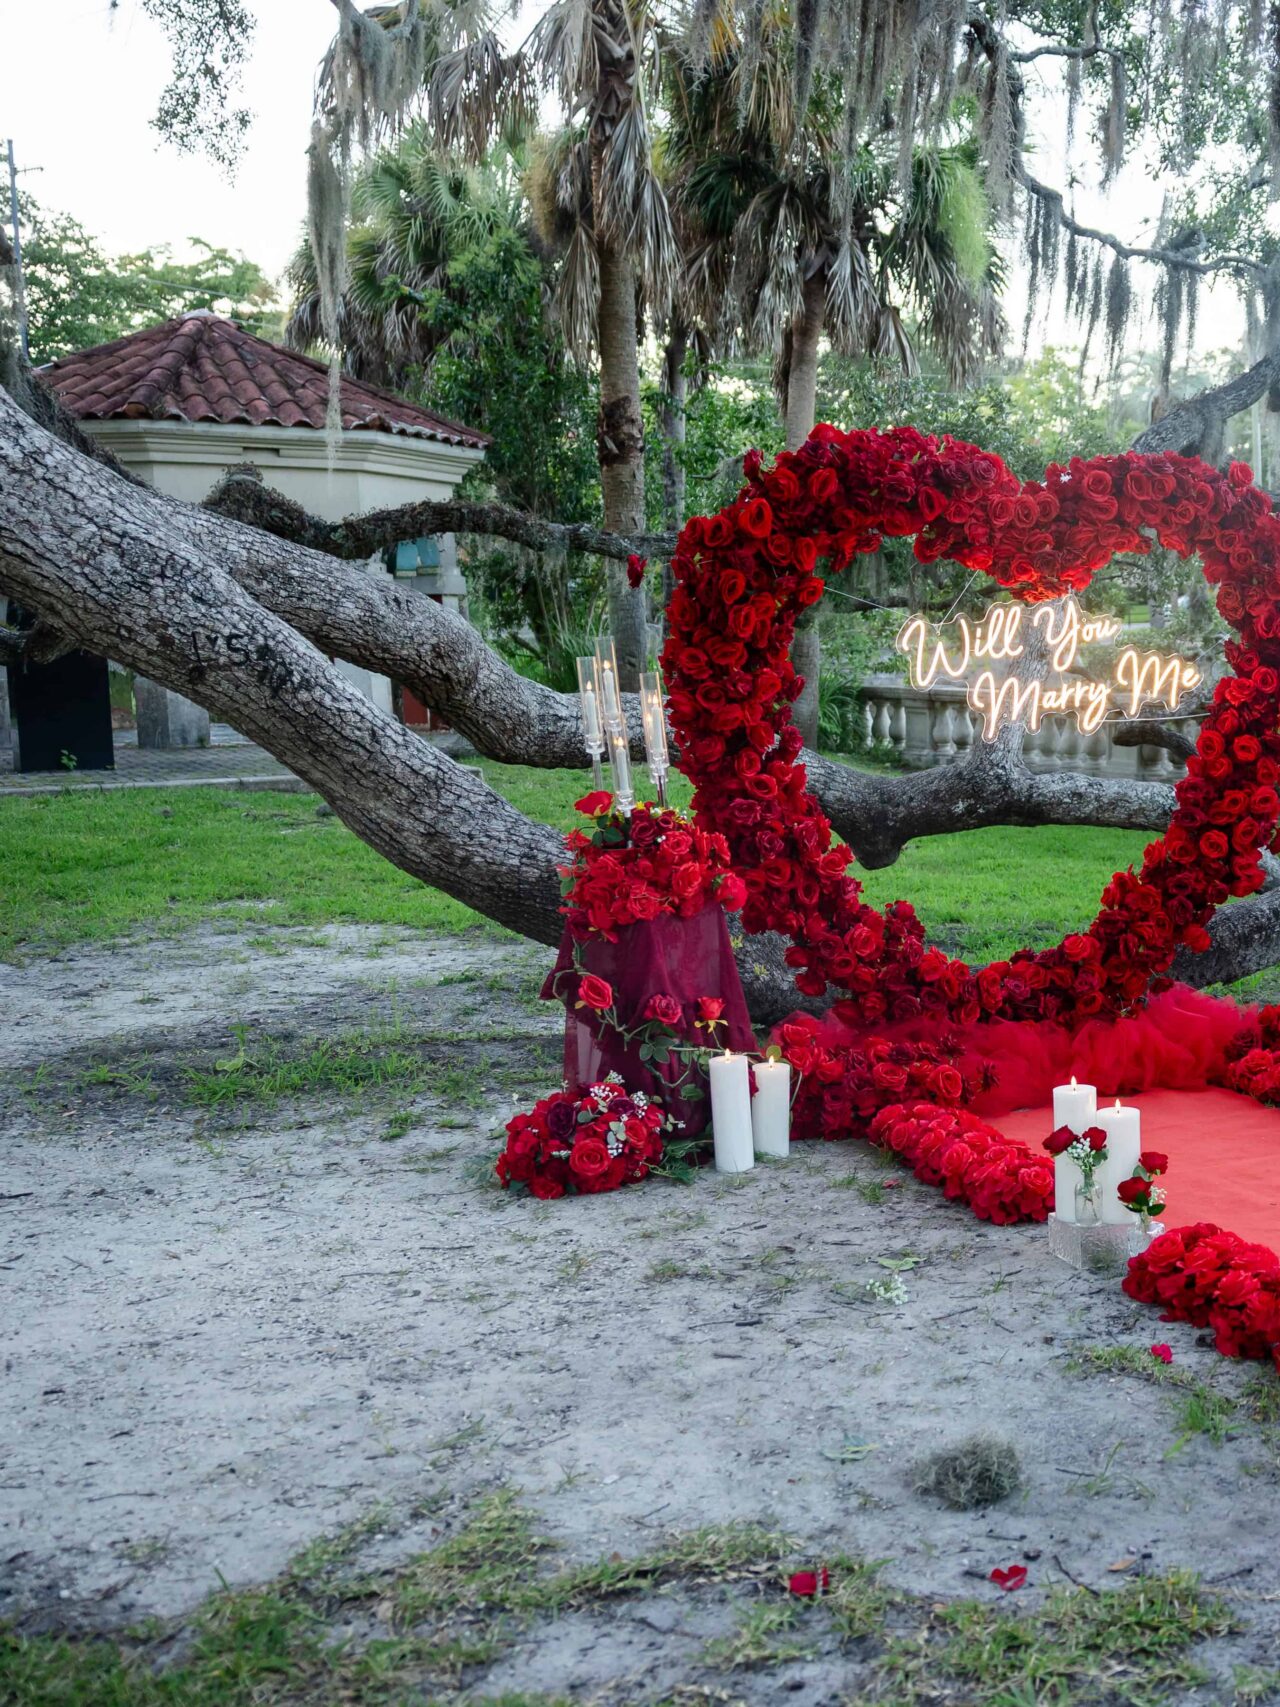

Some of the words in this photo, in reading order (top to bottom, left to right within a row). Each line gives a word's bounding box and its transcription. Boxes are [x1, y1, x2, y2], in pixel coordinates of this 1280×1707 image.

[902, 605, 1024, 687] Will
[1033, 600, 1118, 672] You
[973, 671, 1111, 739] Marry
[1116, 650, 1200, 716] Me
